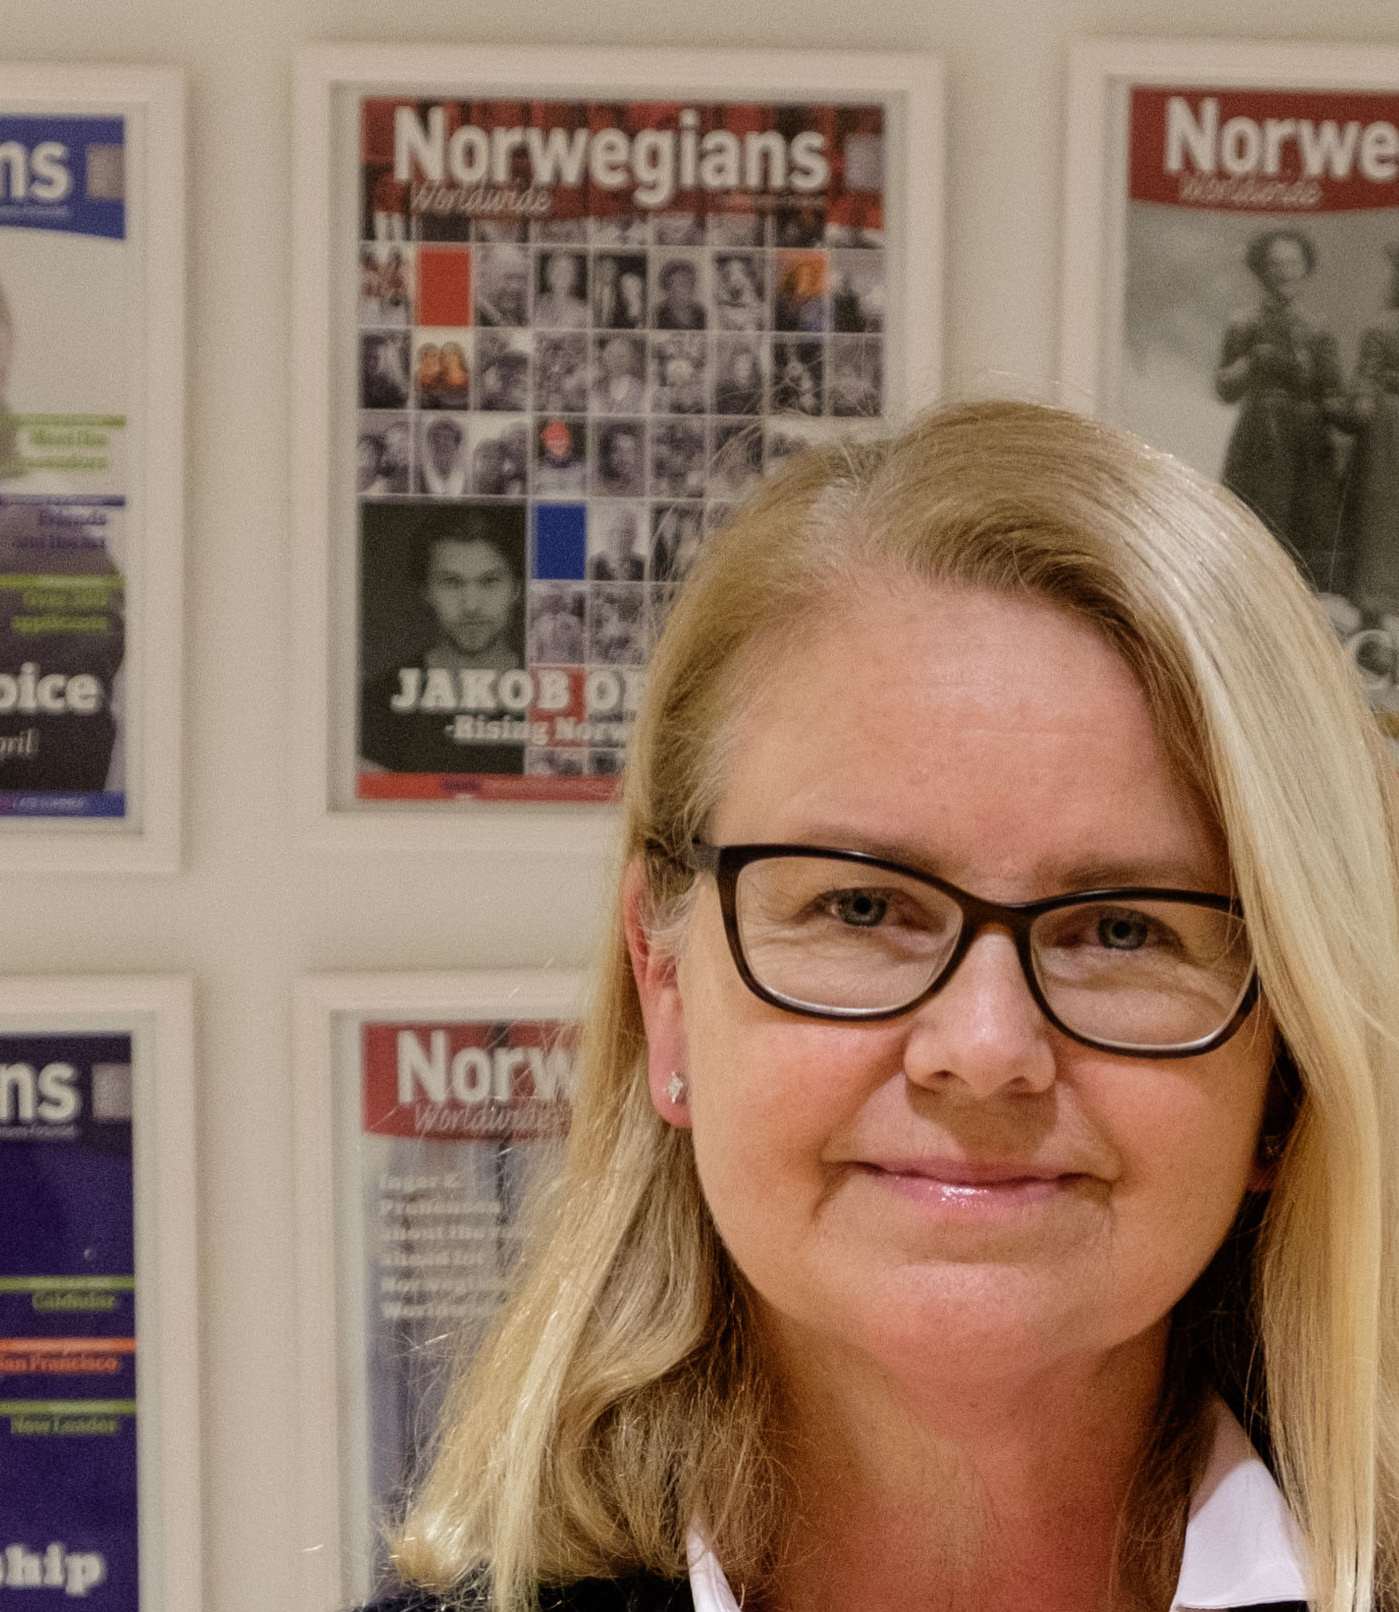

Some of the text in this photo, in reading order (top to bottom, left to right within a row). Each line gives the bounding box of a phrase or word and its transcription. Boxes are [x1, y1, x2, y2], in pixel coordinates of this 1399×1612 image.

[394, 105, 829, 207] Norwegians
[409, 181, 553, 215] Worldwide
[391, 667, 571, 711] JAKOB
